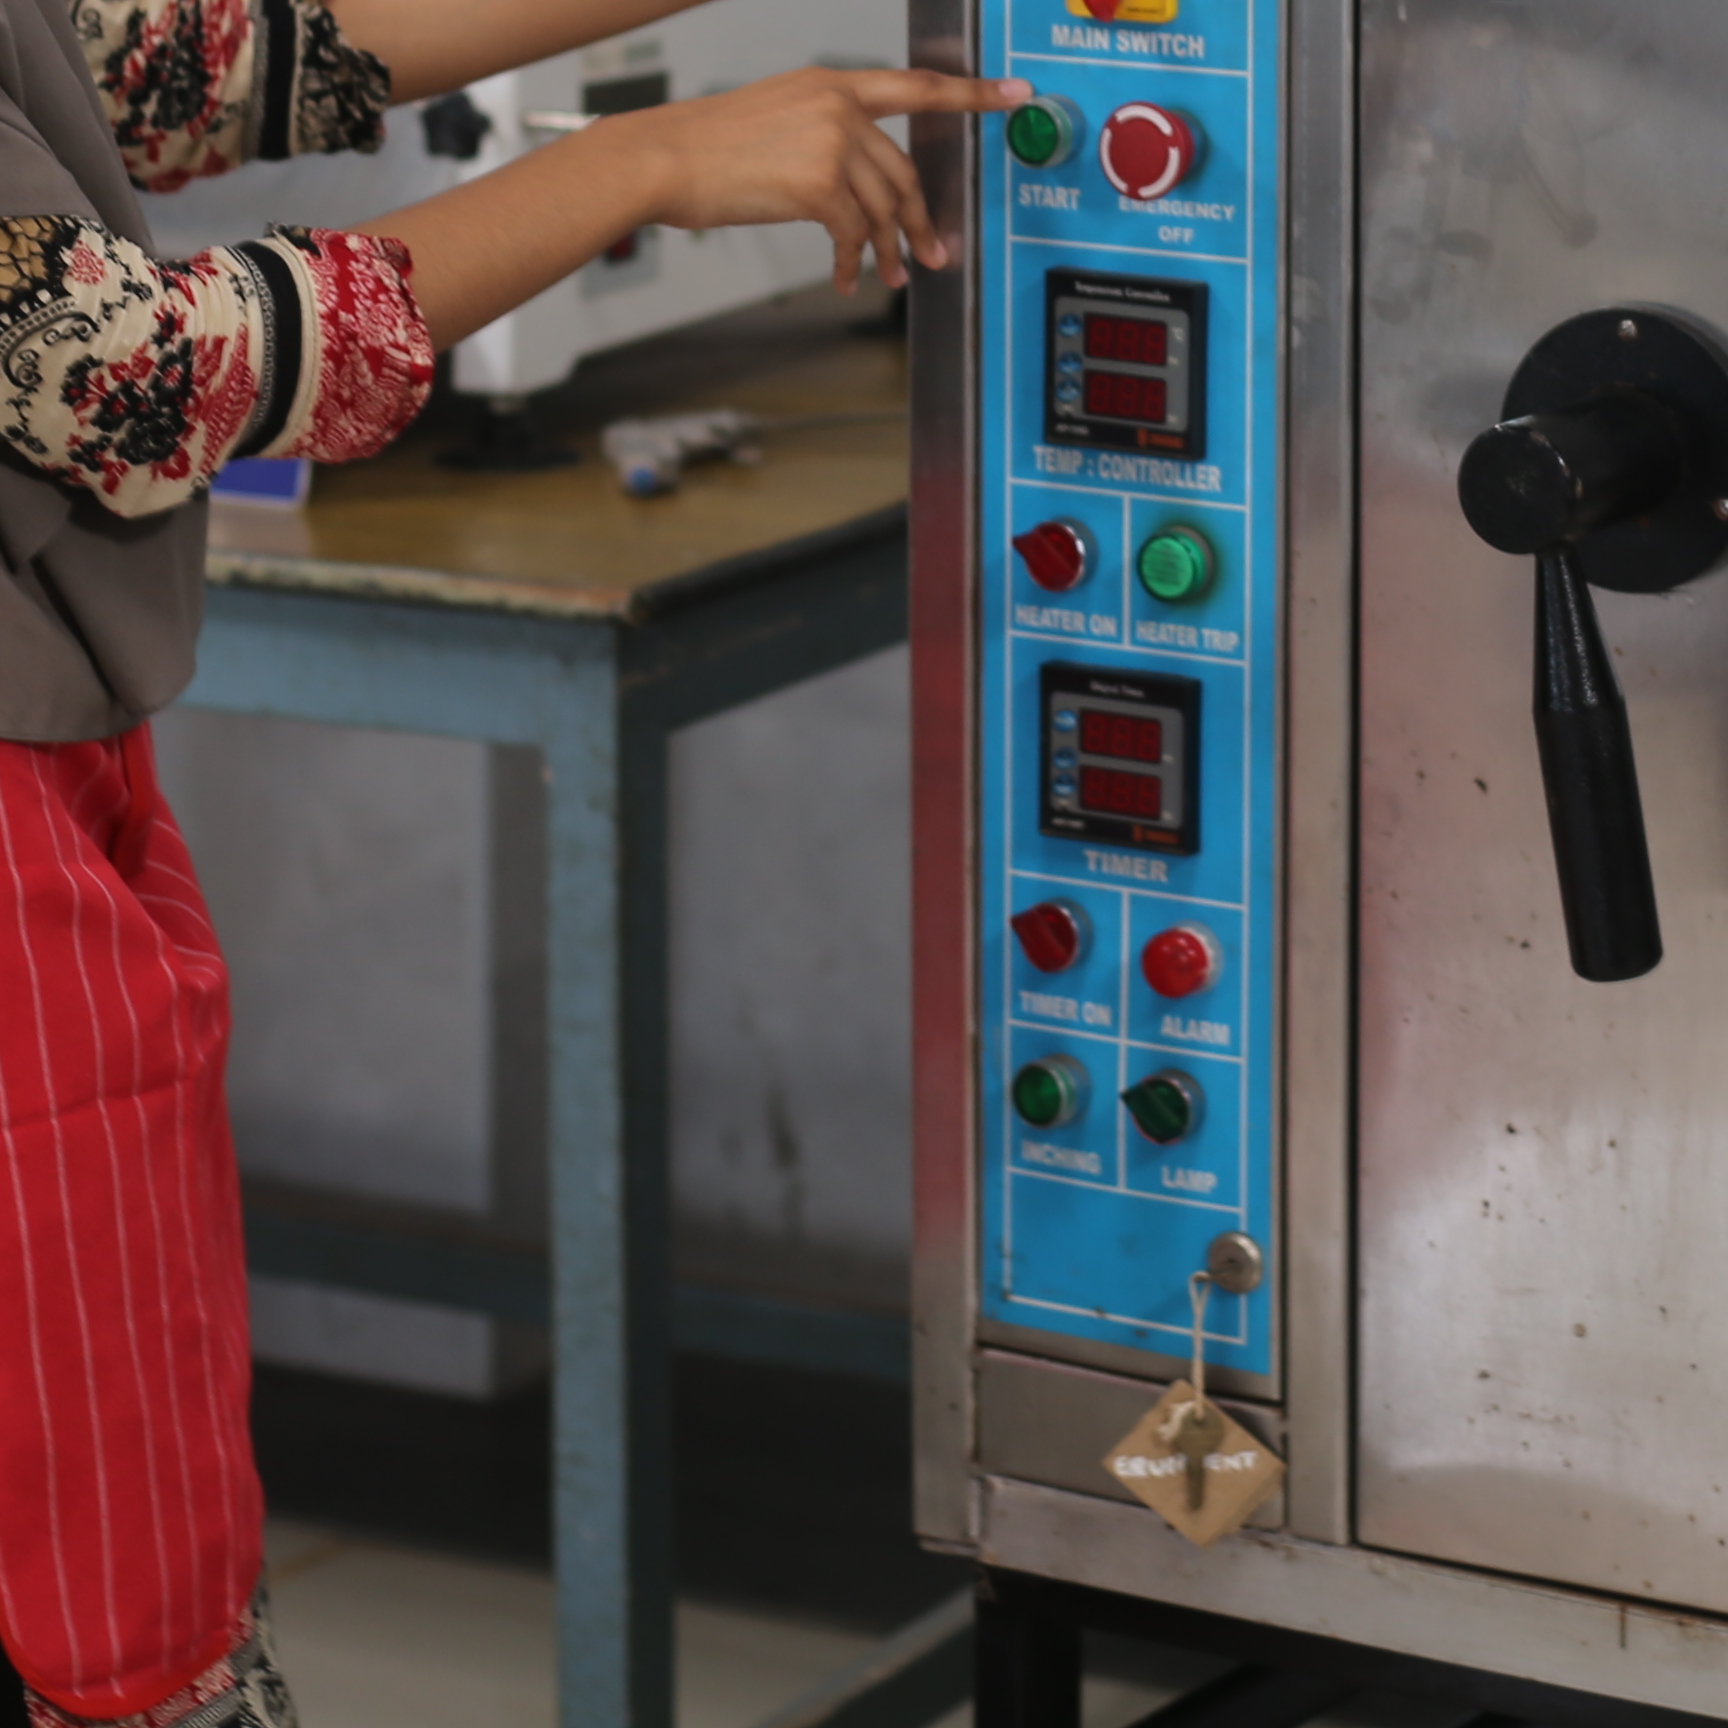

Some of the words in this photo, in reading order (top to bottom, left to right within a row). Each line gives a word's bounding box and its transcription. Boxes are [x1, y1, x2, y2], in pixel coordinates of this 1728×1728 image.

[1051, 25, 1111, 51] MAIN
[1116, 29, 1205, 59] SWITCH
[1018, 184, 1081, 211] START
[1118, 195, 1235, 221] EMERGENCY
[1158, 226, 1195, 244] OFF
[1033, 445, 1084, 474] TEMP
[1098, 454, 1222, 492] CONTROLLER
[1015, 605, 1084, 635] HEATER
[1089, 612, 1117, 637] ON
[1136, 621, 1201, 648] HEATER
[1203, 627, 1239, 651] TRIP
[1083, 849, 1169, 883] TIMER
[1019, 991, 1075, 1022] TIMER
[1082, 1002, 1111, 1027] ON
[1161, 1016, 1230, 1046] ALARM
[1021, 1139, 1101, 1176] INCHING
[1162, 1165, 1218, 1193] LAMP
